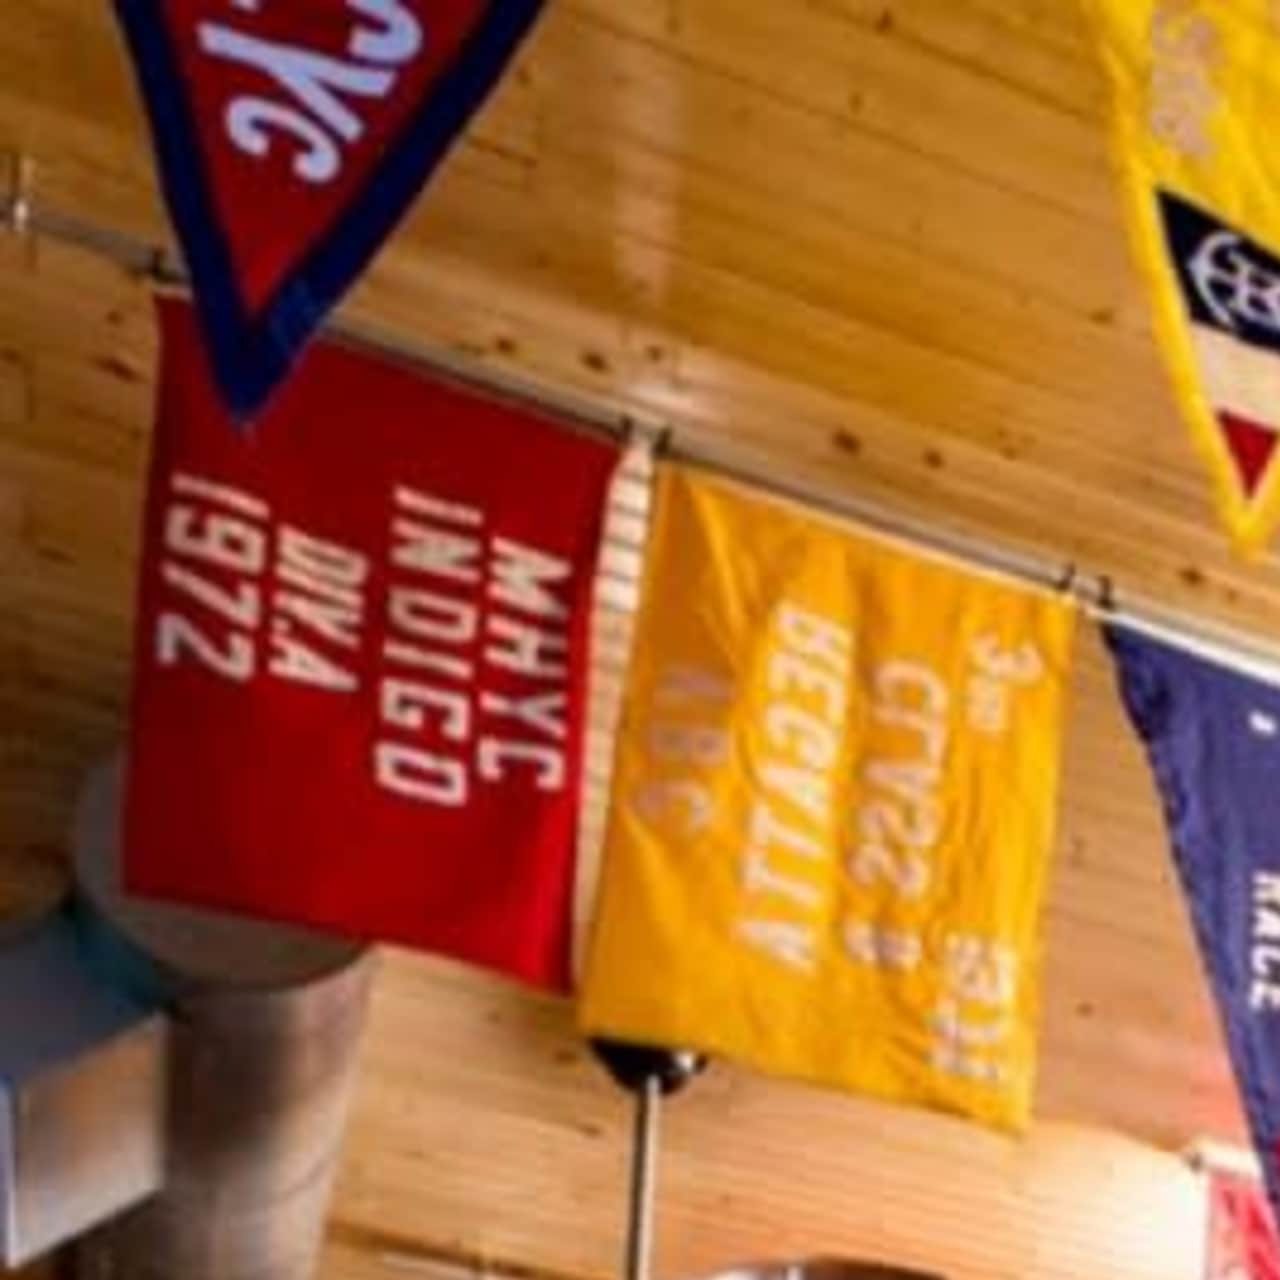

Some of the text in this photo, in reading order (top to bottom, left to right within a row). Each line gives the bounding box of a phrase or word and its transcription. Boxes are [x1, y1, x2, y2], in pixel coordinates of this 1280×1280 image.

[154, 472, 270, 684] 1972
[372, 485, 485, 808] INDIGO
[475, 534, 572, 792] MHYC
